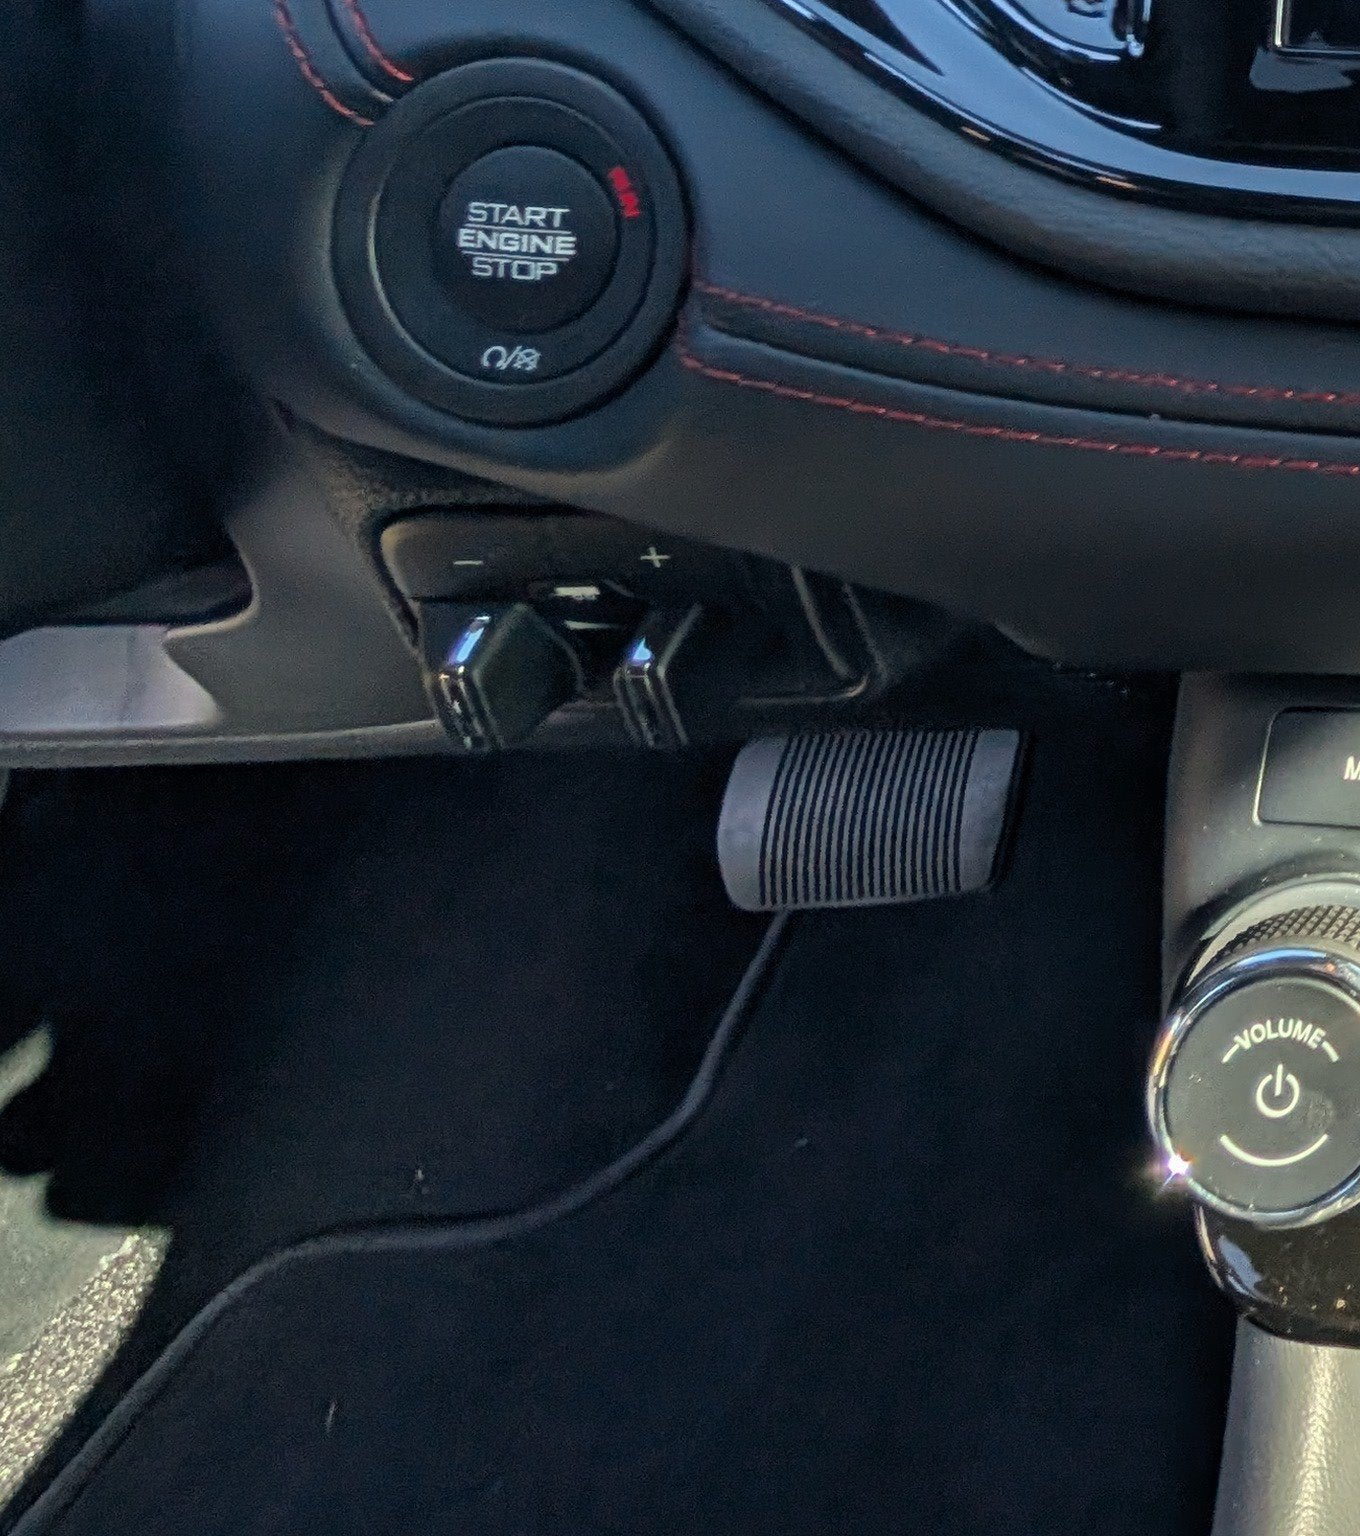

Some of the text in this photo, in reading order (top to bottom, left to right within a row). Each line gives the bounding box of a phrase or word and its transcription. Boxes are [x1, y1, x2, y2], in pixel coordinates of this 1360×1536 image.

[467, 201, 570, 228] START
[457, 228, 578, 256] ENGINE
[471, 256, 558, 281] STOP
[1233, 1017, 1327, 1052] VOLUME
